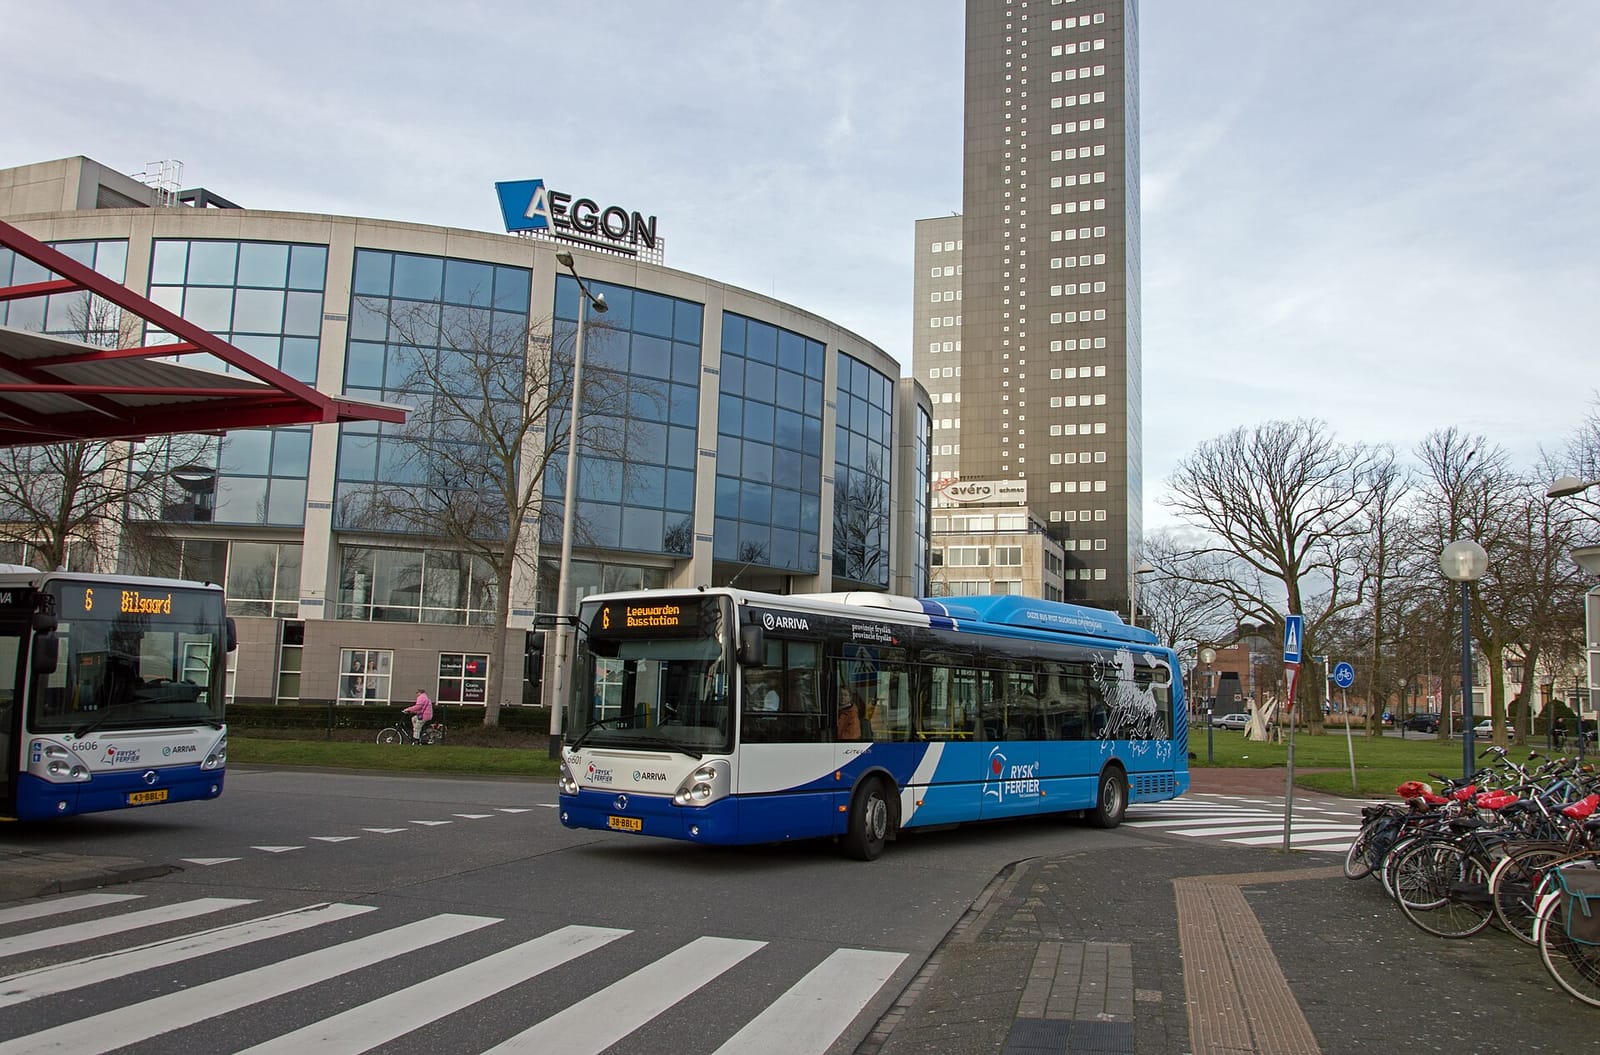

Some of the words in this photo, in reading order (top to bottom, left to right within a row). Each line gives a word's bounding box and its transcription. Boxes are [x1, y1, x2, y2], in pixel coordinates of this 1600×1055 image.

[524, 186, 657, 249] AEGON
[951, 483, 990, 495] avéro
[85, 588, 94, 611] 6
[121, 591, 172, 615] Bilgaard
[602, 607, 610, 629] 6
[627, 604, 680, 616] Leeuwarden
[627, 616, 679, 627] Busstation
[775, 616, 809, 631] ARRIVA
[72, 741, 98, 751] 6606
[172, 745, 197, 753] ARRIVA
[641, 772, 667, 781] ARRIVA
[1004, 779, 1039, 795] FERFIER
[133, 791, 165, 803] 43-BBL-1
[611, 817, 639, 829] 38-BBL-1
